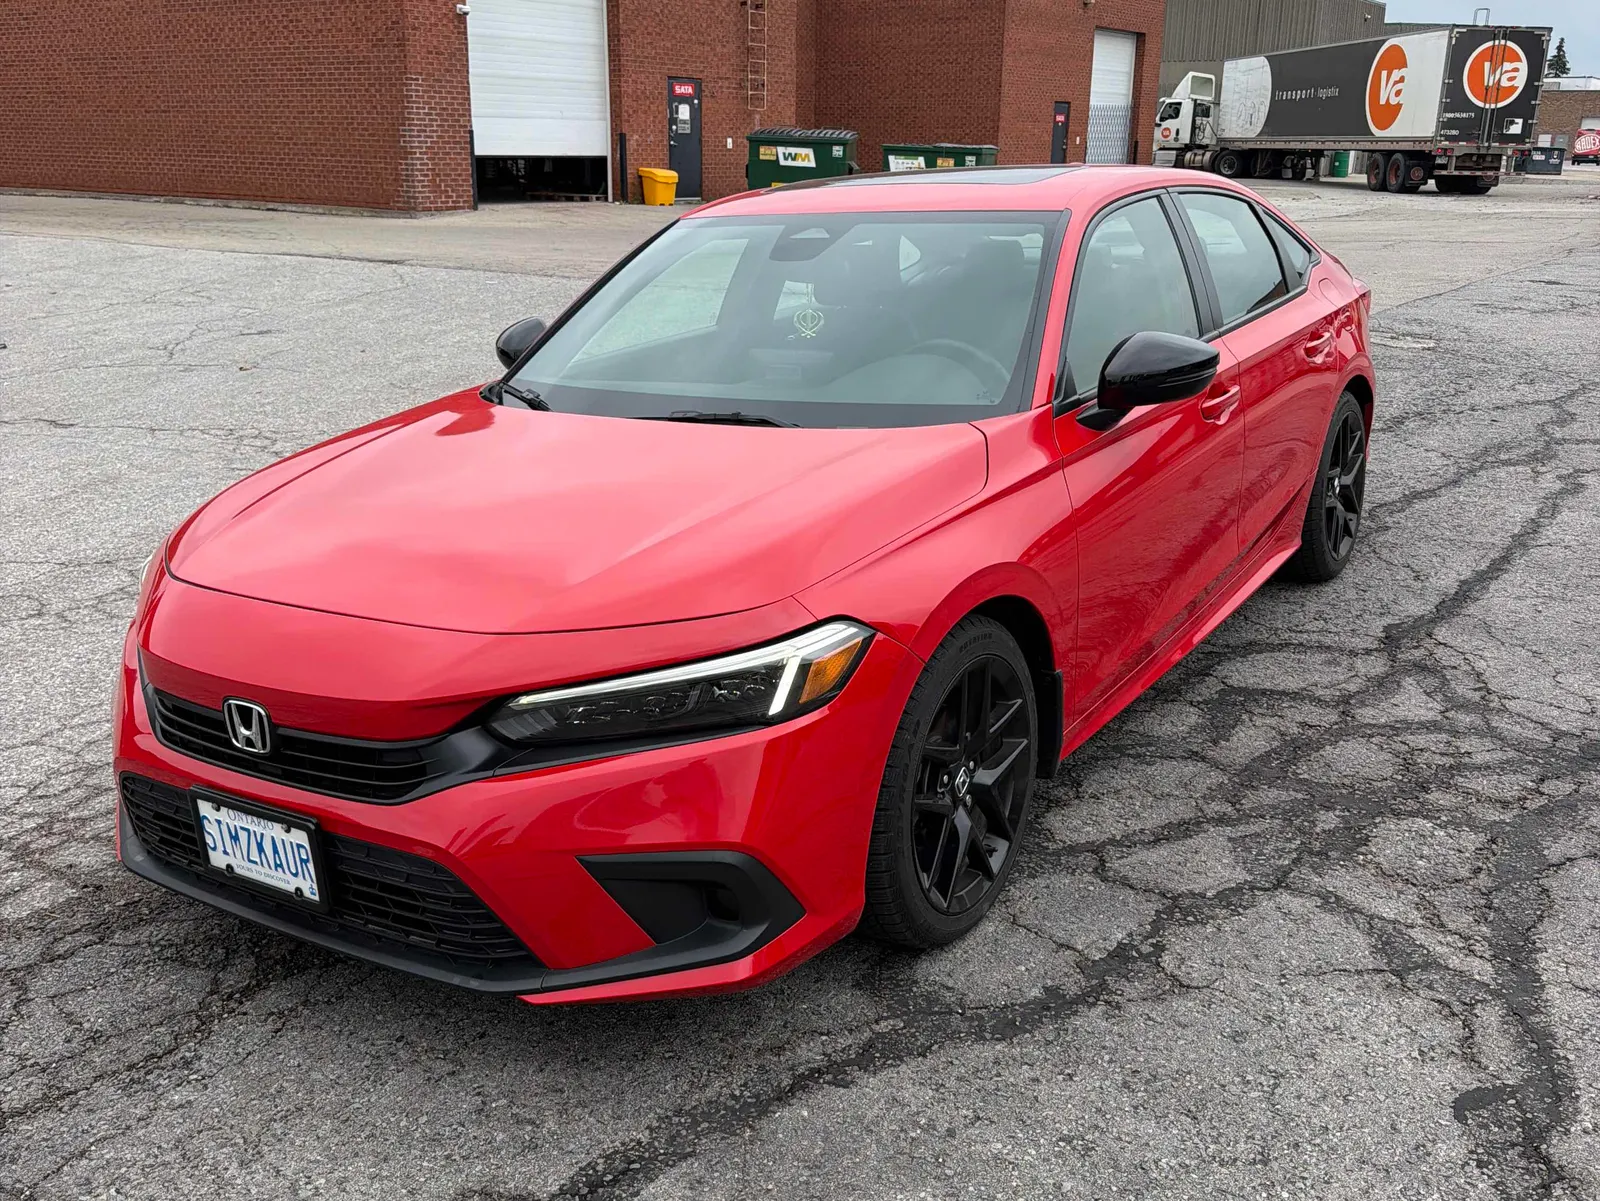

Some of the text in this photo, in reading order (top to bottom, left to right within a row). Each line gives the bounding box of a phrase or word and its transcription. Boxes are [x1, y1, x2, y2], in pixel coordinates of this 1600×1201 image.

[675, 85, 693, 95] SATA
[782, 152, 811, 163] WM
[226, 808, 274, 831] ONTARIO
[201, 814, 315, 884] SIMZKAUR
[235, 863, 291, 886] YOURS TO DISCOVER
